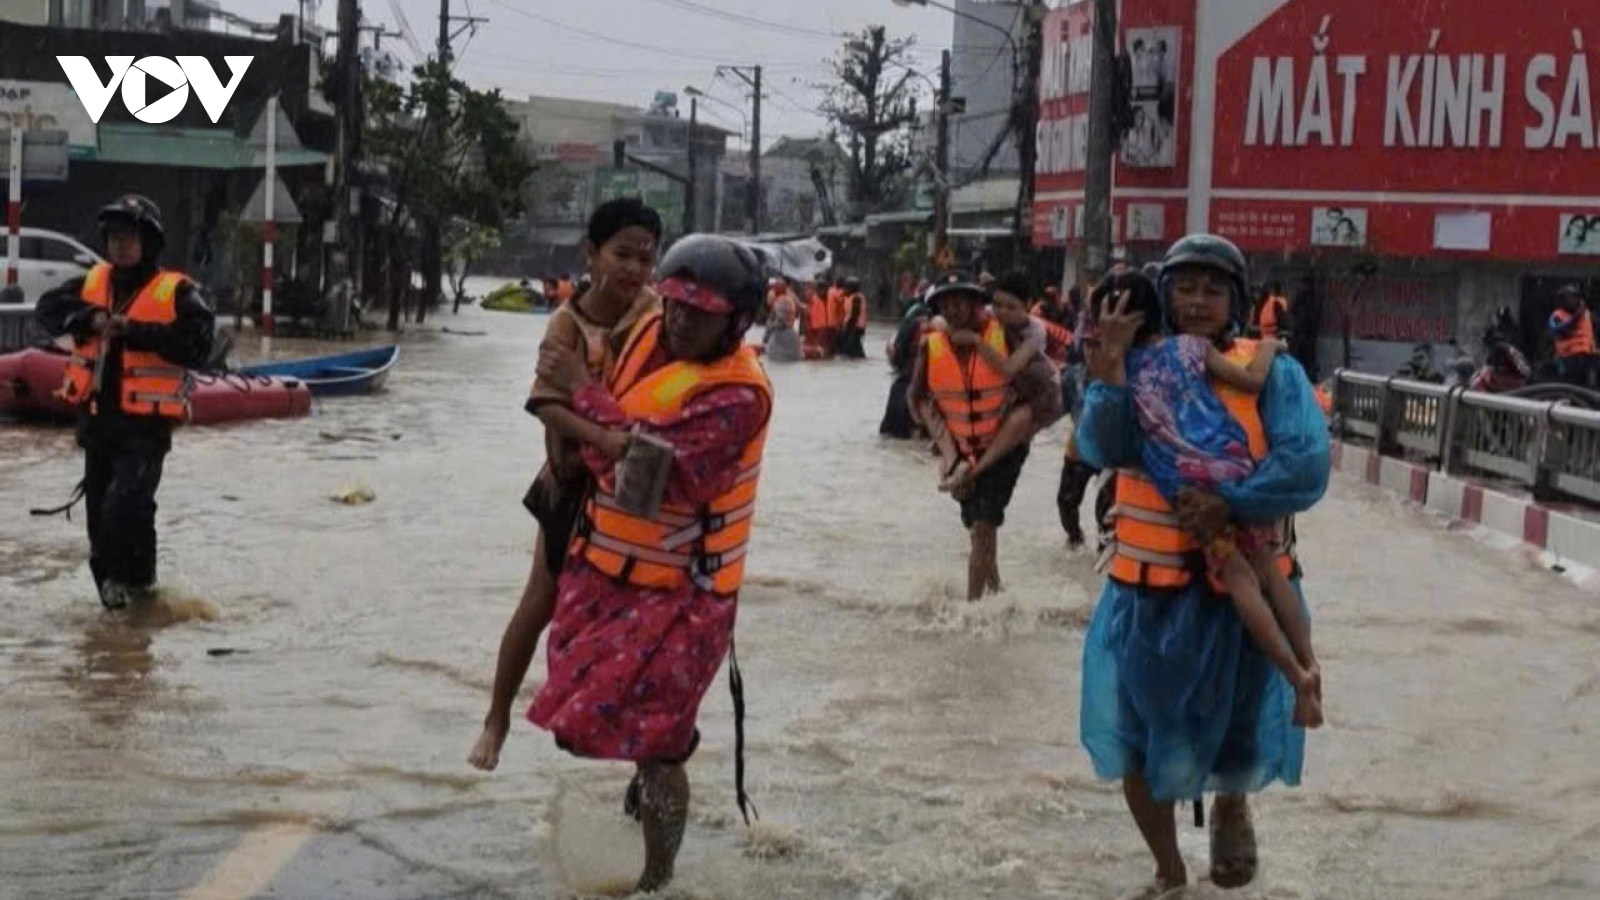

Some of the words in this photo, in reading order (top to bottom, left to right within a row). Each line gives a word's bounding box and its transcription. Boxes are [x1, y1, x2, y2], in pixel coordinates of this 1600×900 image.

[1244, 14, 1366, 147] MẮT
[1383, 27, 1506, 148] KÍNH
[1524, 27, 1600, 148] SÀ
